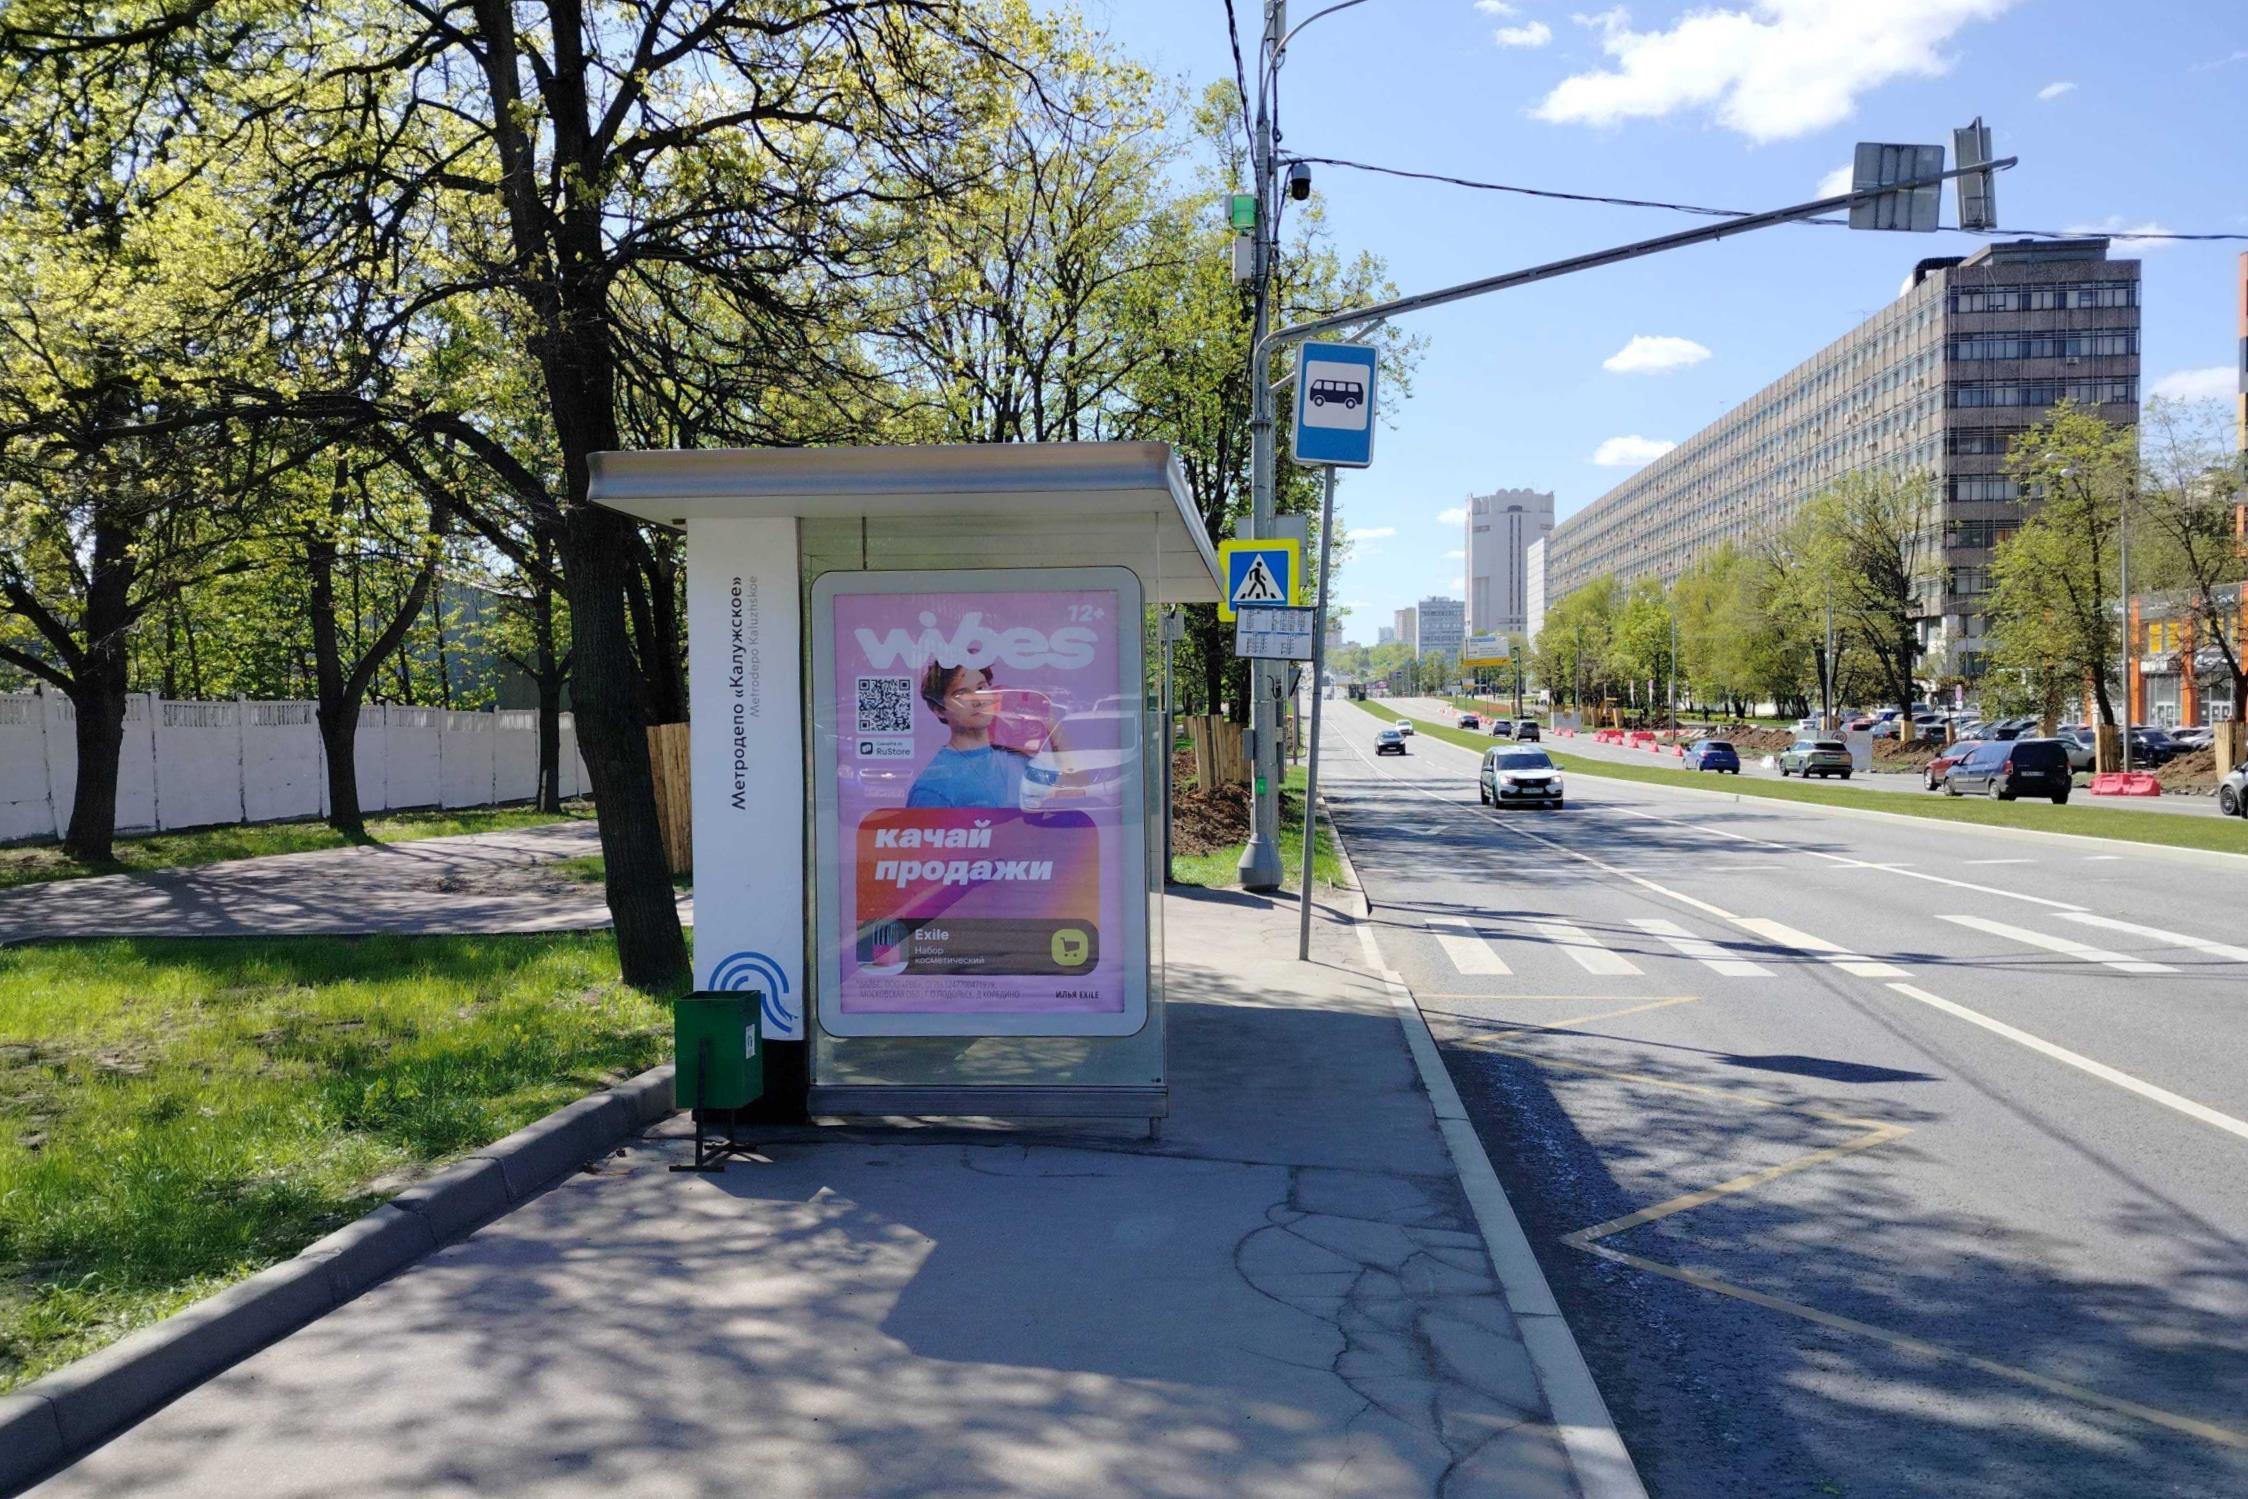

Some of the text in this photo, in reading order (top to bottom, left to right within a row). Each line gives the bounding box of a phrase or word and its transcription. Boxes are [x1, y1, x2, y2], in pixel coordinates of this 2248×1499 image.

[1067, 605, 1105, 623] 12+
[748, 575, 761, 718] Metrodepo Kaluzhskoe
[729, 576, 749, 810] Метродепо «Калужское»
[876, 748, 911, 756] RuStore
[875, 819, 992, 849] качай
[875, 859, 1053, 888] продажи
[914, 929, 949, 941] Exile
[914, 946, 944, 956] Набор
[914, 956, 985, 965] косметический
[1055, 991, 1099, 999] ИЛЬЯ EXILE
